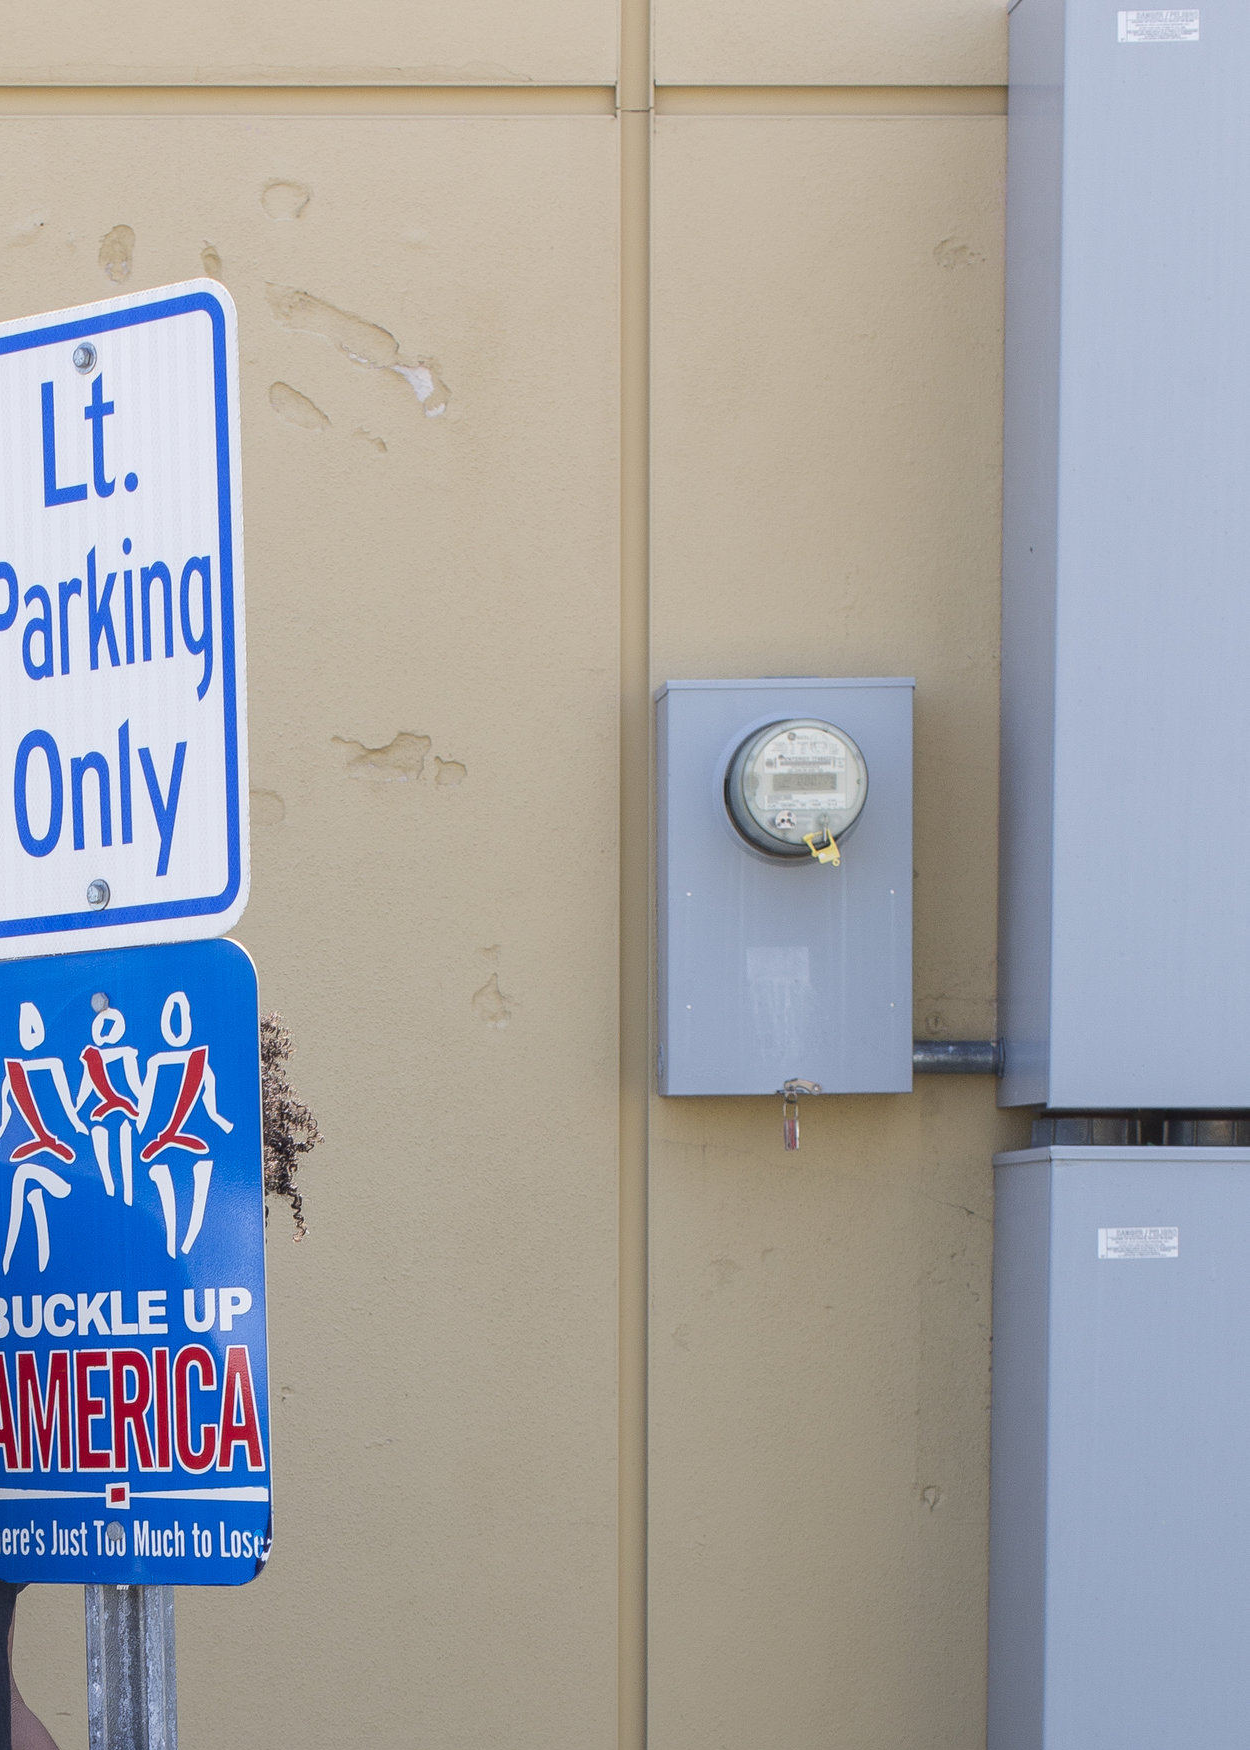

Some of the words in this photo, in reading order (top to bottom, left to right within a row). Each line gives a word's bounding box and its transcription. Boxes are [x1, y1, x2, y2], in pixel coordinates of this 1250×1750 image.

[41, 371, 139, 508] Lt.
[14, 718, 187, 877] Only
[183, 1287, 252, 1333] UP
[51, 1521, 88, 1557] Just
[93, 1519, 127, 1558] Too
[134, 1519, 186, 1559] Much
[192, 1525, 212, 1558] to
[219, 1520, 265, 1559] Lose
